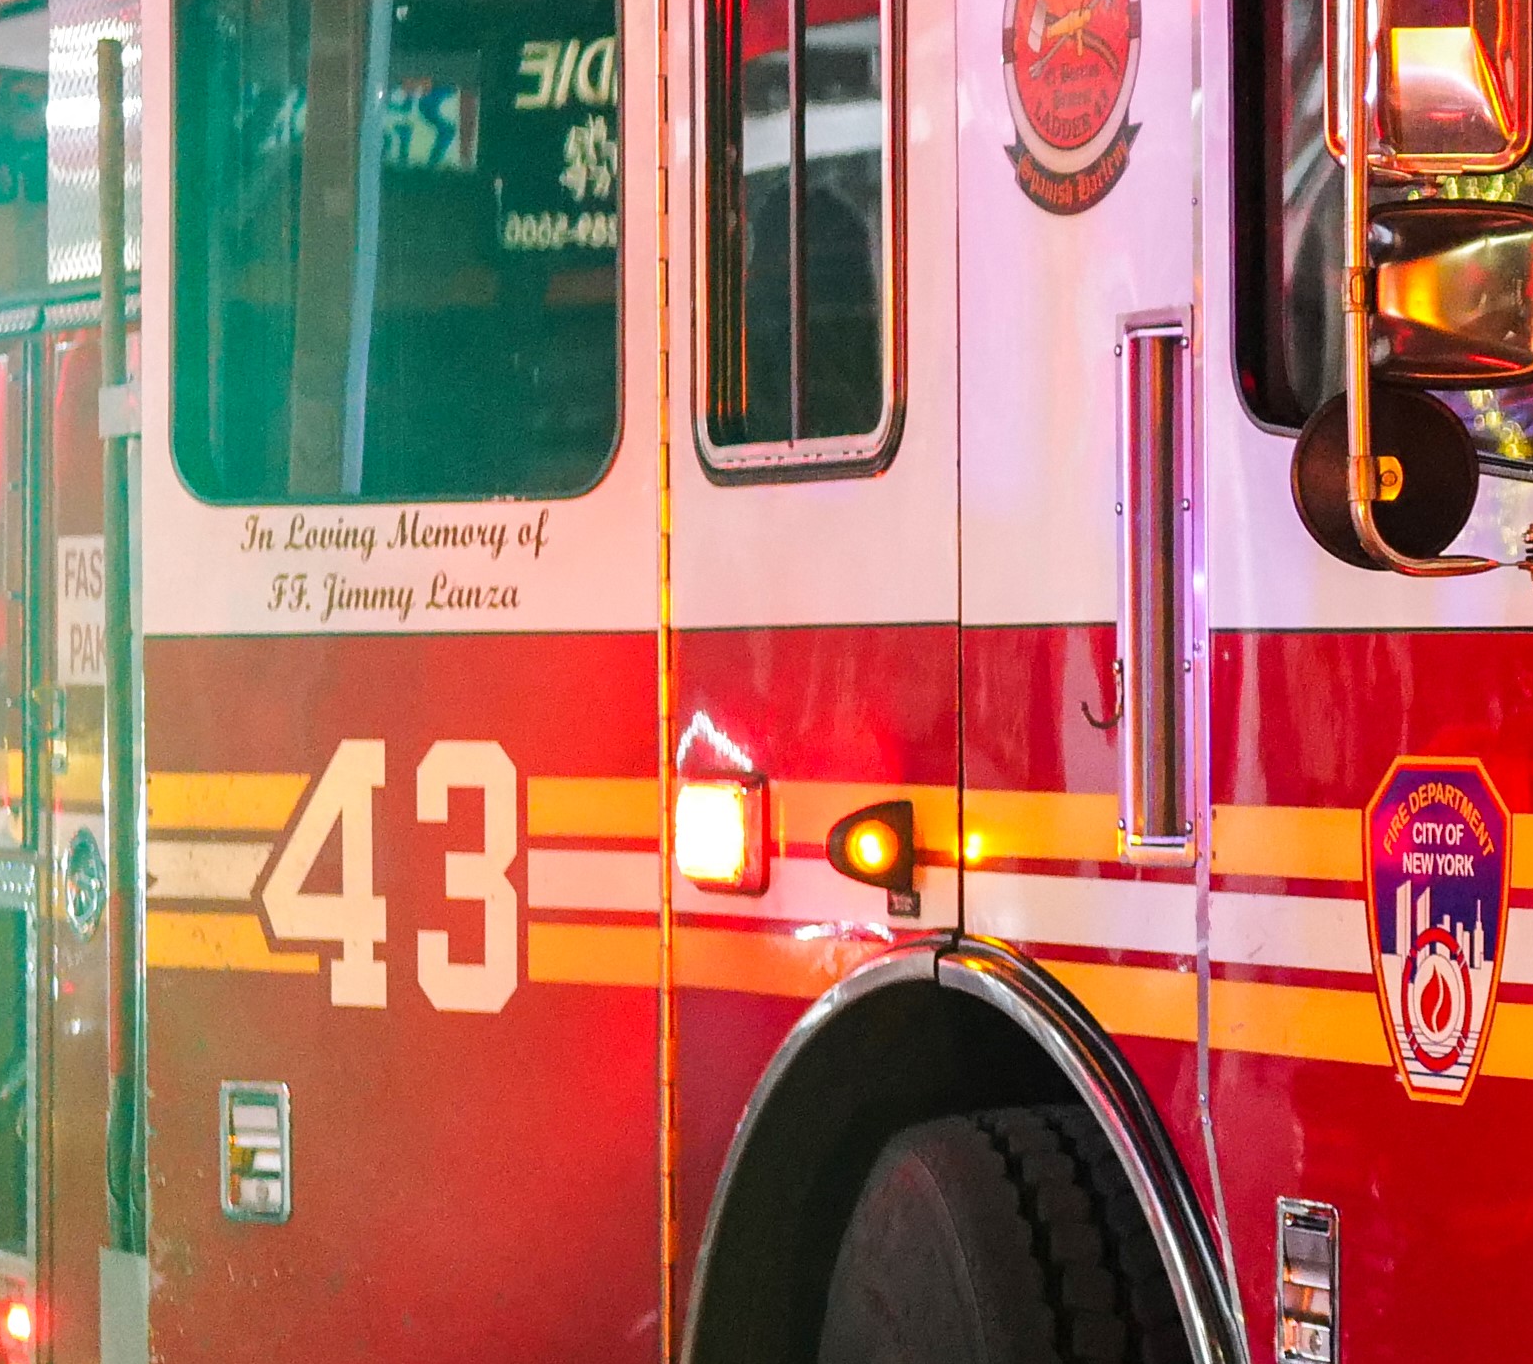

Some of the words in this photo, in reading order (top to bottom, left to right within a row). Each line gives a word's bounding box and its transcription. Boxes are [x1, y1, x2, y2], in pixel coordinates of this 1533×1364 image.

[240, 514, 275, 553] In
[285, 515, 375, 560] Loving
[386, 510, 509, 561] Memory
[517, 509, 549, 557] of
[320, 573, 416, 623] Jimmy
[424, 572, 521, 612] Lanza
[1383, 801, 1410, 857] FIRE
[1408, 782, 1495, 858] DEPARTMENT
[1412, 821, 1443, 846] CITY
[1445, 822, 1465, 846] OF
[260, 738, 518, 1014] 43
[1402, 852, 1435, 875] NEW
[1436, 853, 1475, 877] YORK
